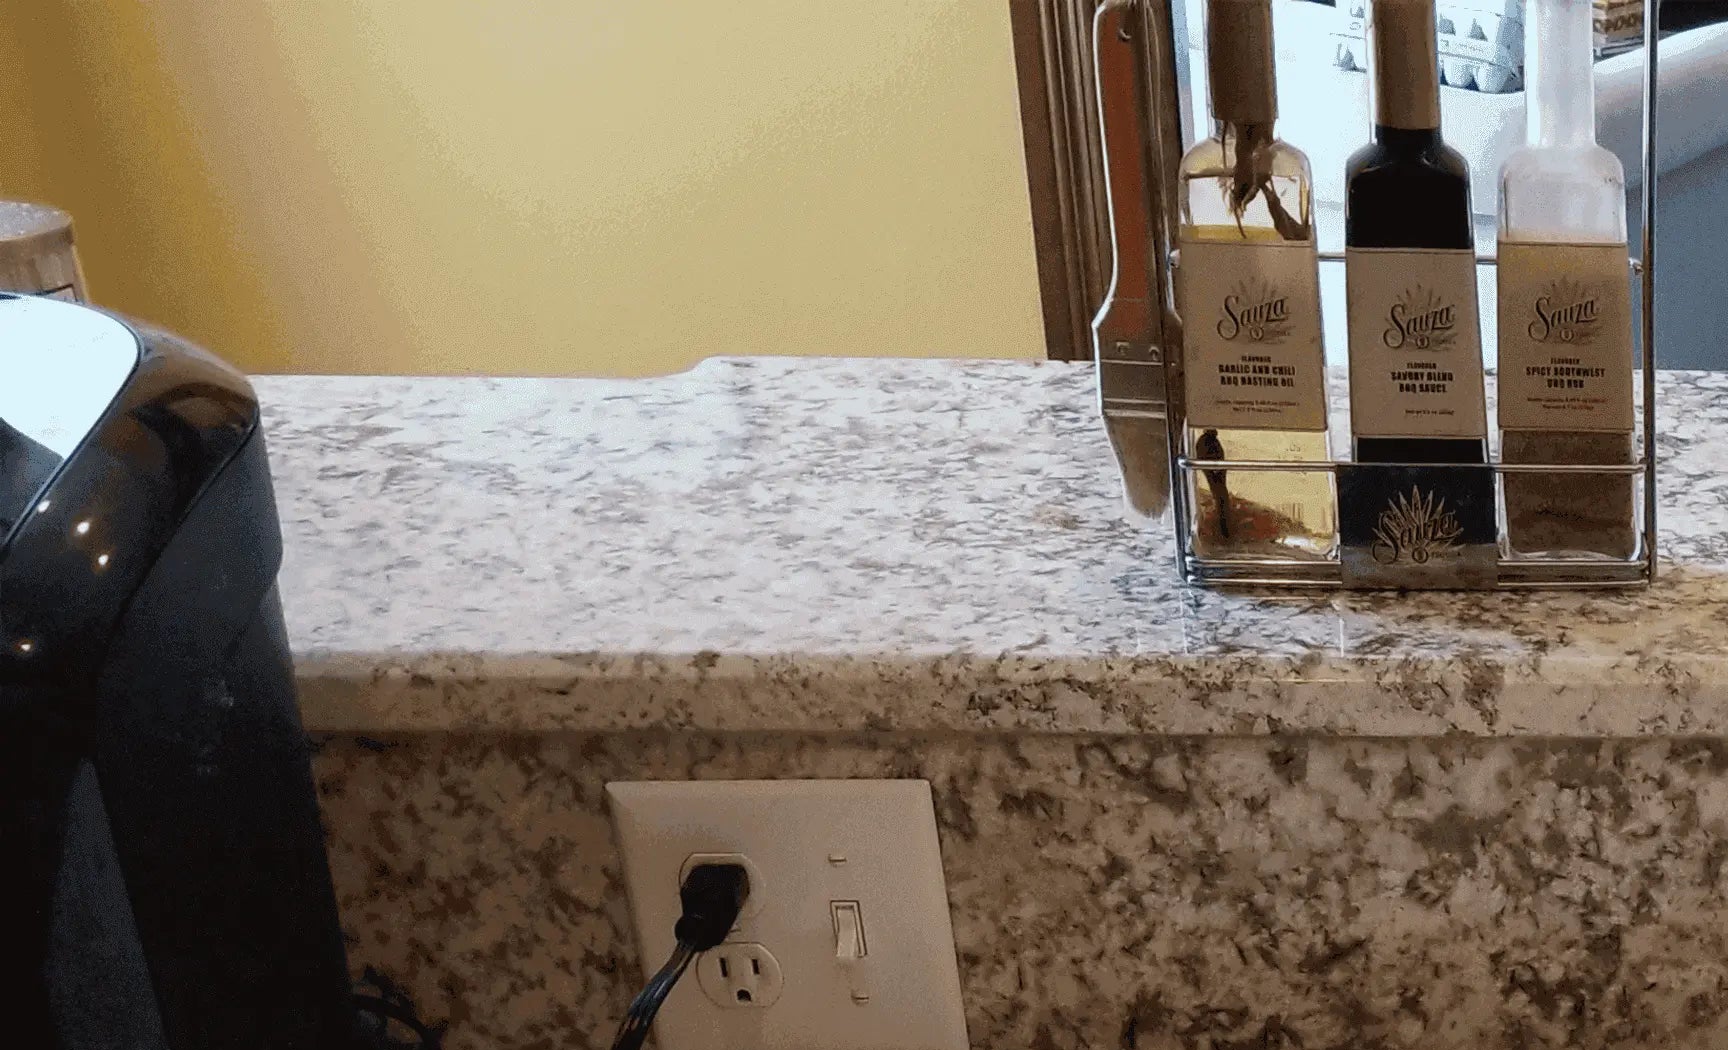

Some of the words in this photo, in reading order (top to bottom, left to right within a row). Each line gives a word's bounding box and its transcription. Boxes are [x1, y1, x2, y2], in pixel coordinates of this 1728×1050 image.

[1217, 295, 1289, 340] Sauza
[1528, 296, 1599, 343] Sauza
[1383, 303, 1455, 349] Sauza
[1218, 364, 1251, 374] GARLIC
[1252, 365, 1270, 375] AND
[1272, 365, 1296, 376] CHILI
[1526, 366, 1552, 377] SPICY
[1553, 366, 1606, 378] SOUTHWEST
[1220, 376, 1239, 387] BBQ
[1240, 376, 1279, 387] BASTING
[1281, 377, 1295, 388] OIL
[1390, 371, 1425, 381] SAVORY
[1426, 371, 1454, 382] BLEND
[1418, 383, 1448, 393] SAUCE
